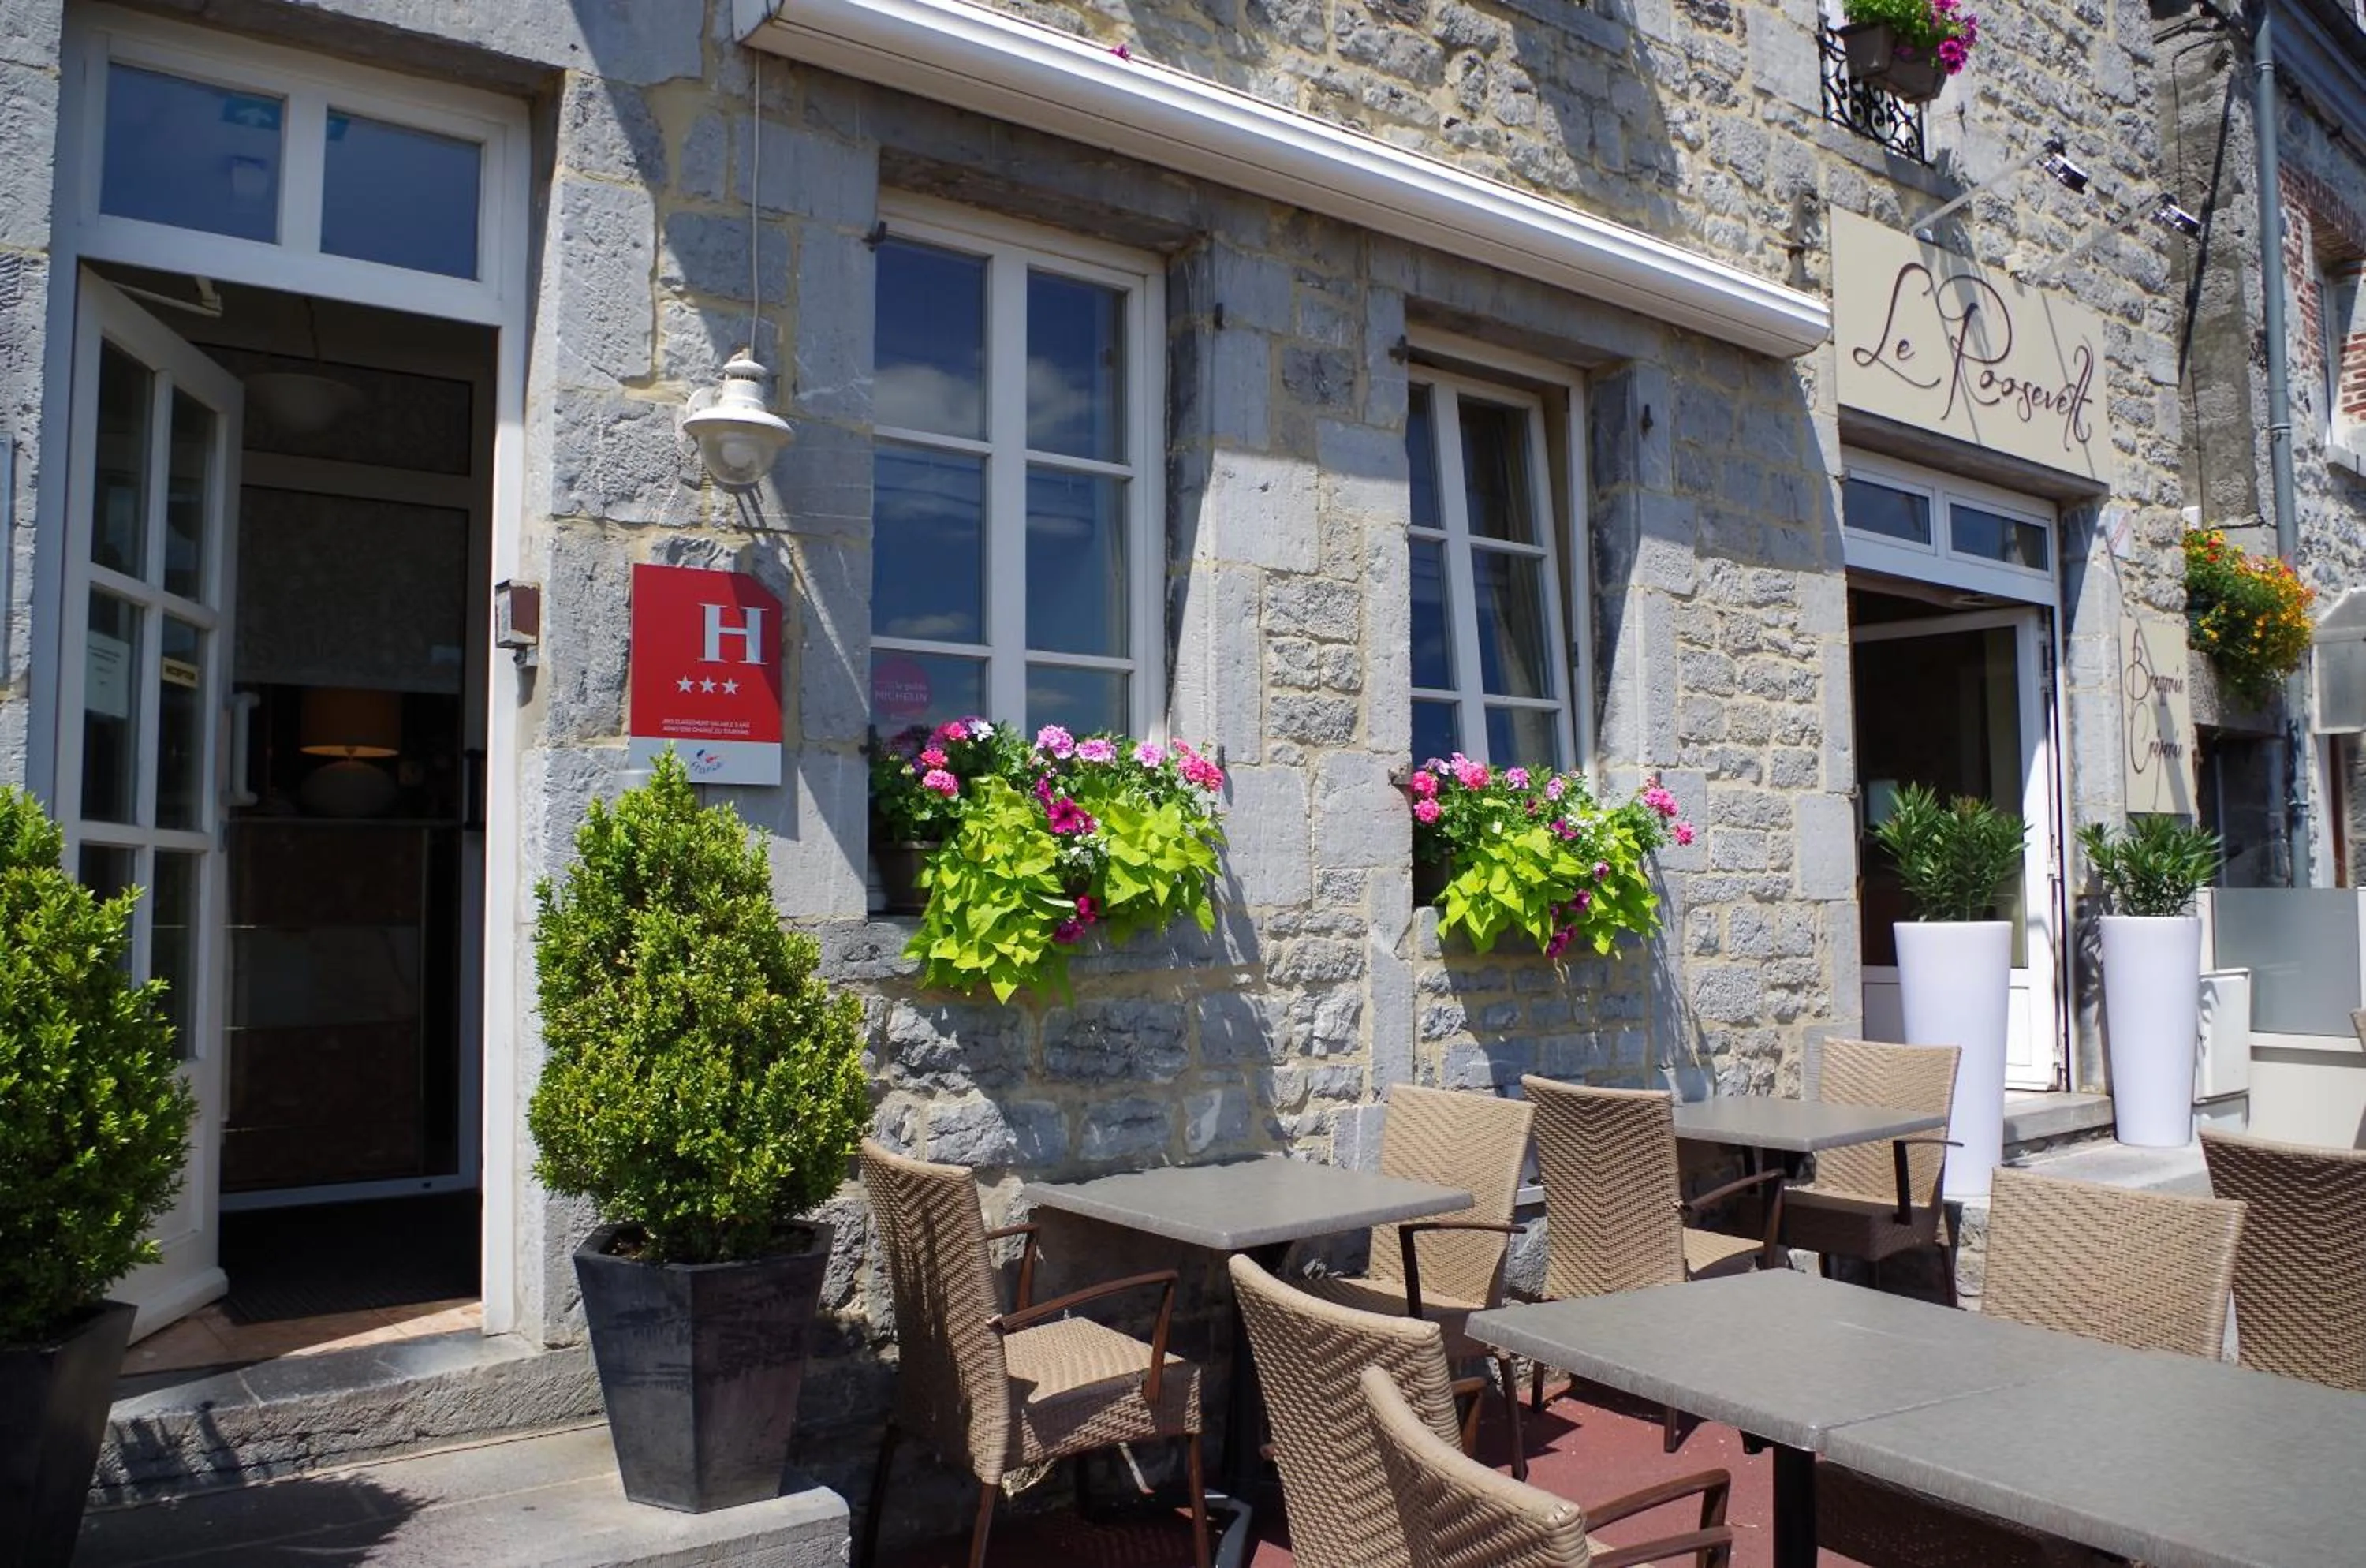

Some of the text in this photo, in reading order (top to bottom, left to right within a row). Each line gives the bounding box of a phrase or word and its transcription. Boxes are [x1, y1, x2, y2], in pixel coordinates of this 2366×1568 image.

[1853, 263, 2093, 452] Le Roosevelt
[697, 602, 769, 665] H
[2125, 629, 2184, 707] Brasserie
[875, 689, 928, 703] MICHELIN
